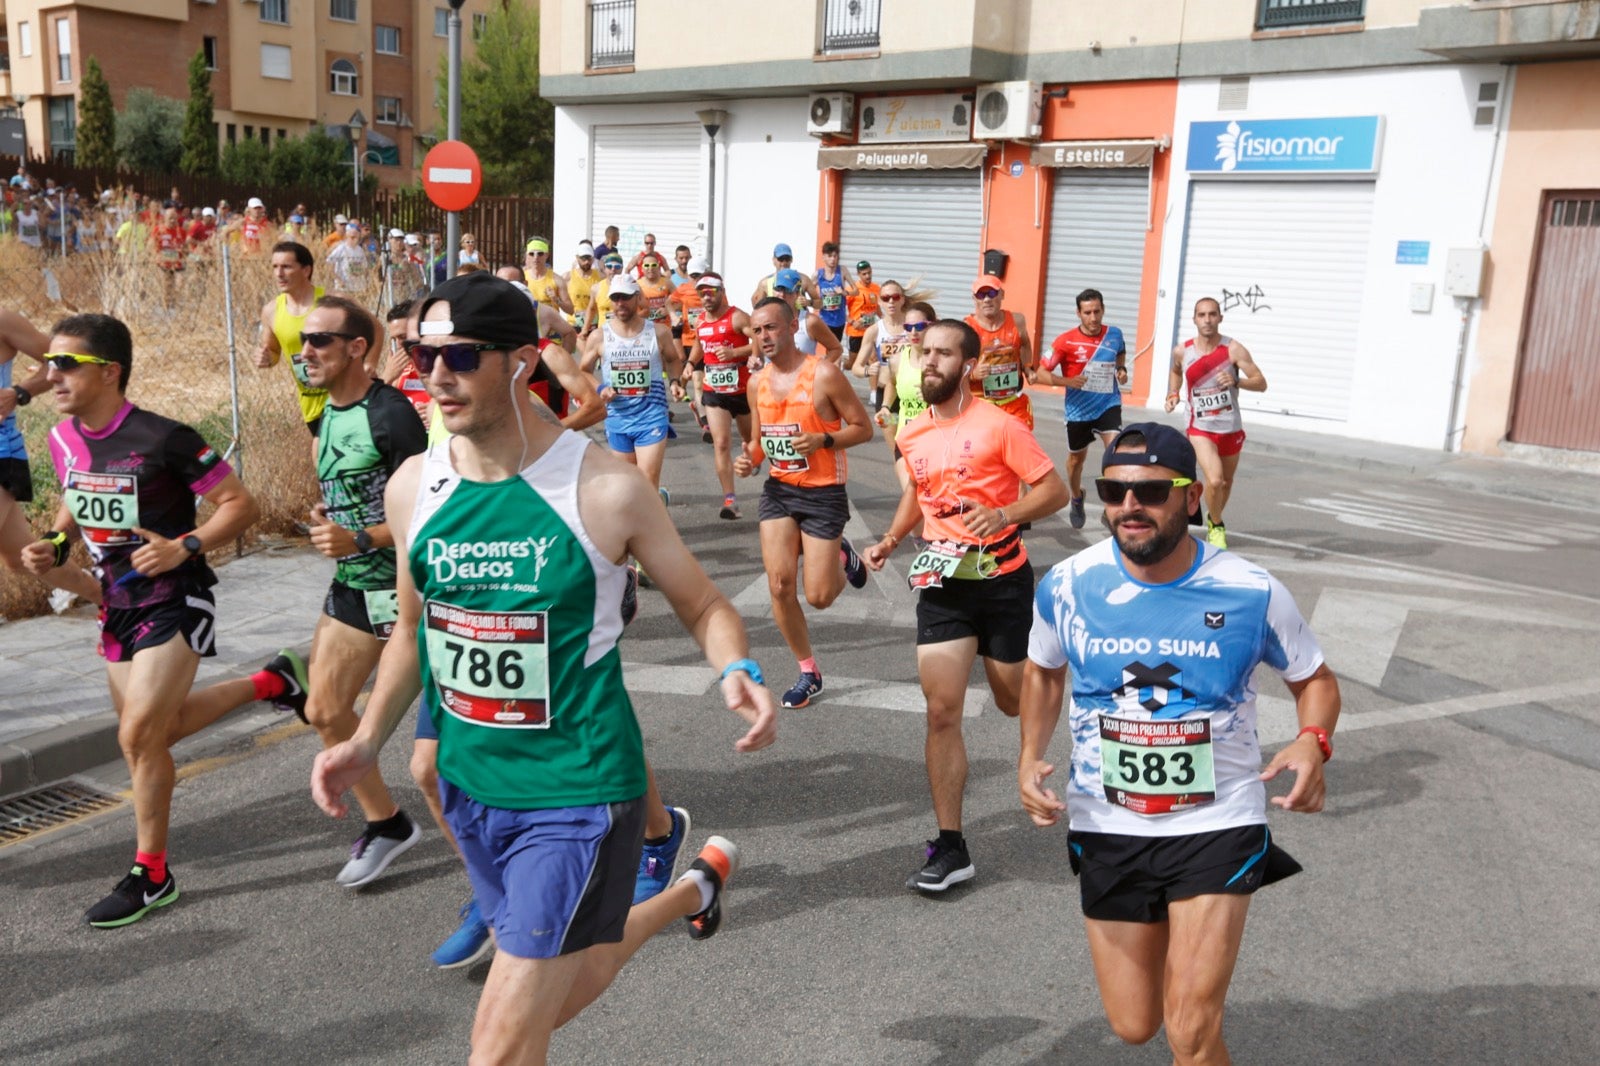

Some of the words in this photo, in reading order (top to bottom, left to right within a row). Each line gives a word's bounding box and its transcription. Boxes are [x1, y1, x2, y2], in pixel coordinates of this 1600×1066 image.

[1237, 131, 1344, 162] fisiomar
[856, 152, 928, 167] Peluqueria
[1055, 148, 1125, 163] Estetica
[611, 350, 652, 359] MARACENA
[617, 371, 646, 386] 503
[711, 372, 734, 384] 596
[994, 374, 1010, 388] 14
[1198, 393, 1229, 408] 3019
[766, 439, 796, 457] 945
[76, 495, 125, 523] 206
[427, 538, 530, 565] DEPORTES
[434, 555, 514, 583] DELFOS
[1090, 637, 1152, 655] TODO
[1158, 638, 1221, 659] SUMA
[445, 641, 525, 690] 786
[1120, 721, 1138, 735] GRAN
[1139, 723, 1168, 736] PREMIO
[1169, 723, 1179, 736] DE
[1180, 722, 1204, 735] FONDO
[1118, 748, 1196, 786] 583
